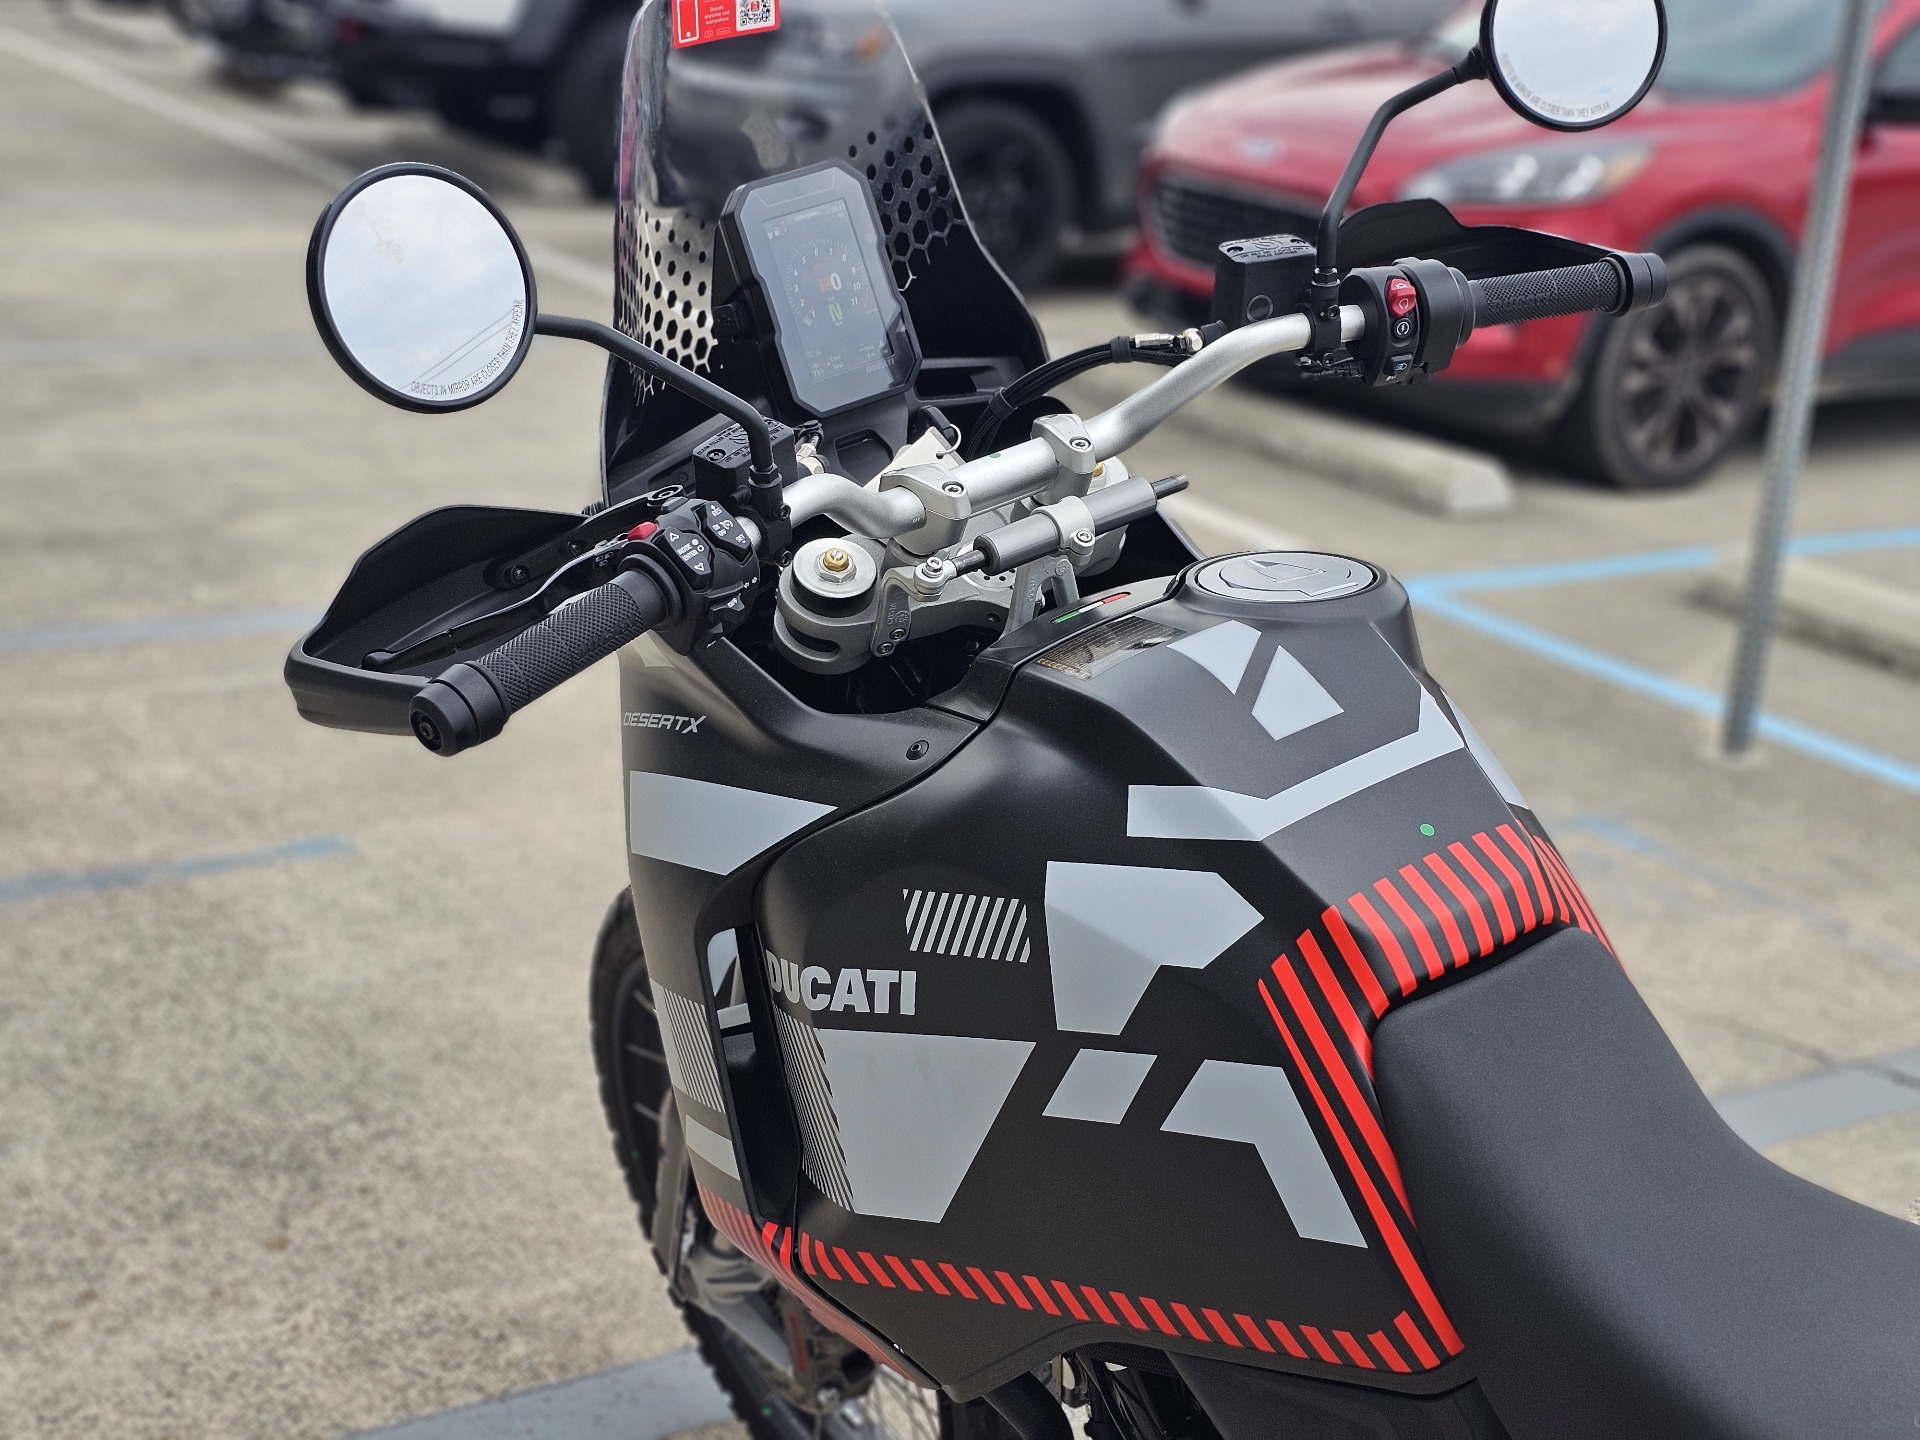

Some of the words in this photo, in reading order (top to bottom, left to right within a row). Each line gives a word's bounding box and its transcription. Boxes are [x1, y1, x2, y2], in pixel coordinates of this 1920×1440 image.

[814, 248, 819, 256] 6
[829, 248, 833, 256] 7
[842, 253, 847, 262] 8
[802, 256, 806, 264] 5
[793, 268, 798, 276] 4
[851, 266, 856, 275] 9
[794, 284, 799, 293] 3
[853, 282, 861, 291] 10
[800, 299, 805, 307] 2
[851, 297, 858, 306] 11
[511, 299, 524, 326] APPEAR
[828, 302, 844, 322] N
[506, 326, 519, 345] THEY
[497, 343, 512, 363] THAN
[481, 357, 503, 380] CLOSER
[866, 358, 895, 373] DUCATI
[470, 373, 484, 388] ARE
[411, 381, 439, 396] OBJECTS
[440, 384, 447, 395] IN
[447, 379, 472, 395] MIRROR
[677, 543, 693, 555] MODE
[682, 549, 699, 561] ENTER
[623, 712, 707, 733] DESERTX
[766, 949, 916, 1015] DUCATI
